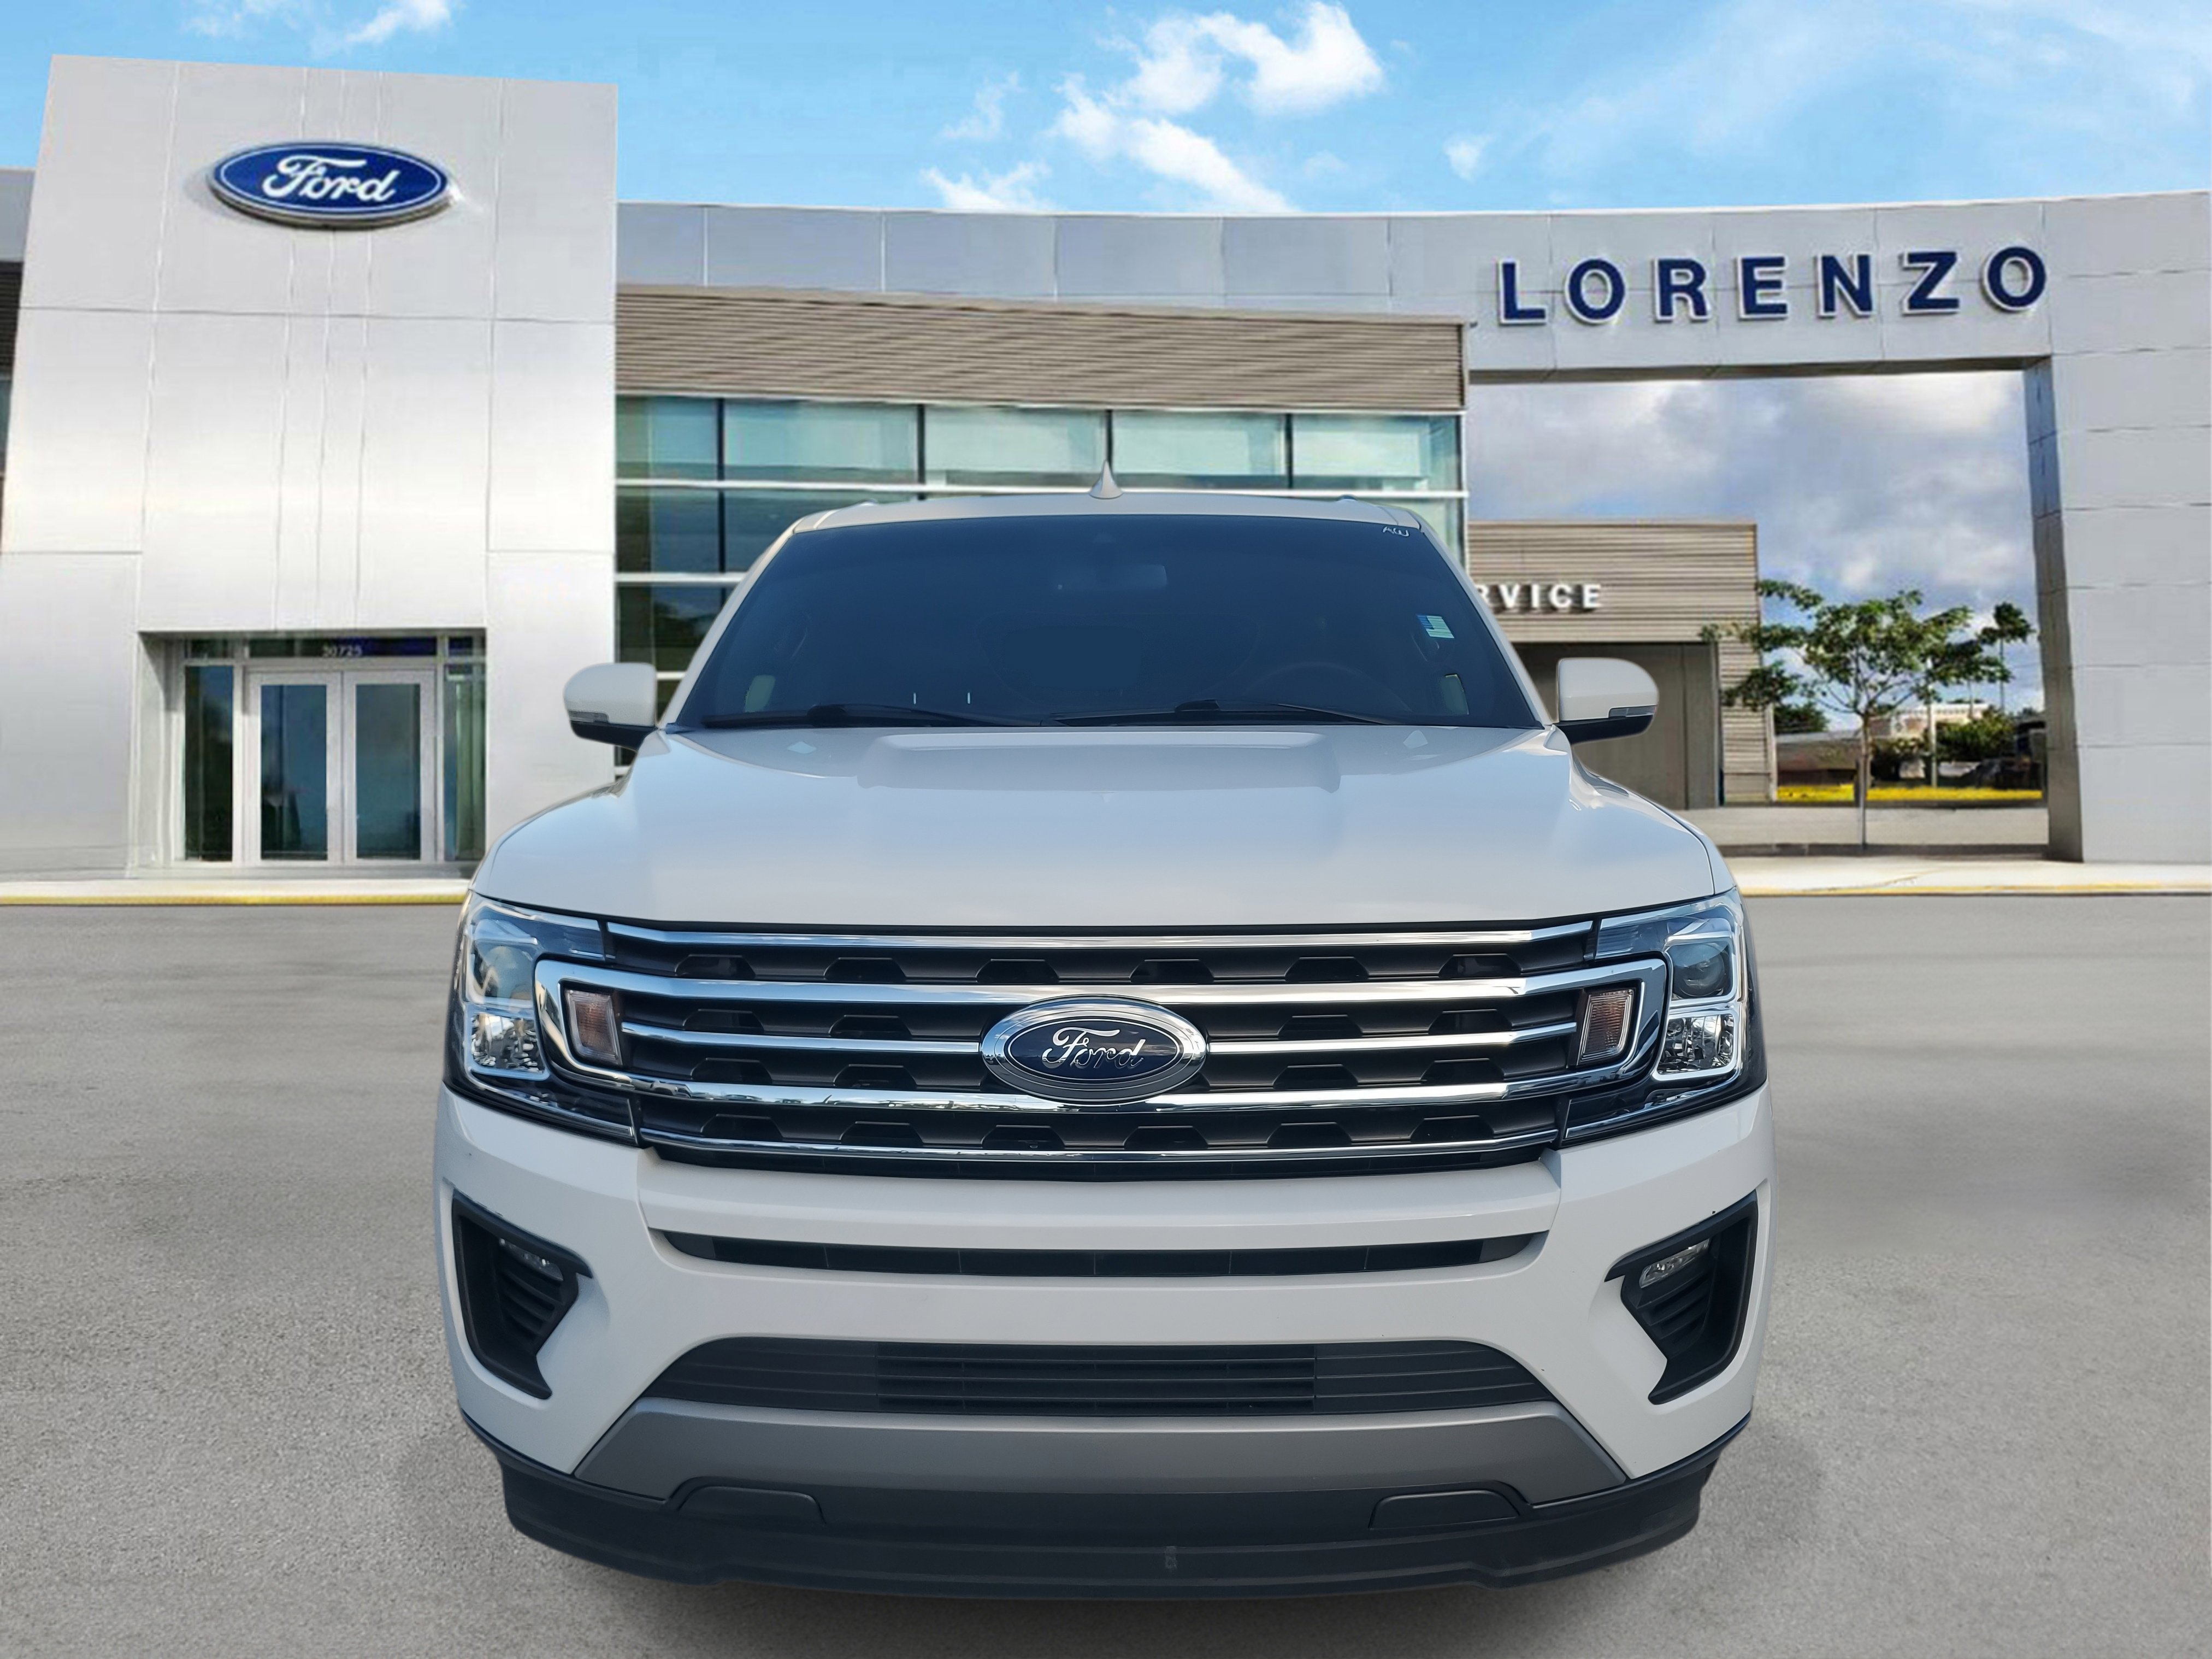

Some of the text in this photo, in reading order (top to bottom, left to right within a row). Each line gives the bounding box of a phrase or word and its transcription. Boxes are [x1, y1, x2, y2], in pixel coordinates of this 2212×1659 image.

[262, 154, 400, 203] Ford
[1496, 247, 2047, 326] LORENZO
[1042, 1027, 1147, 1069] Ford
